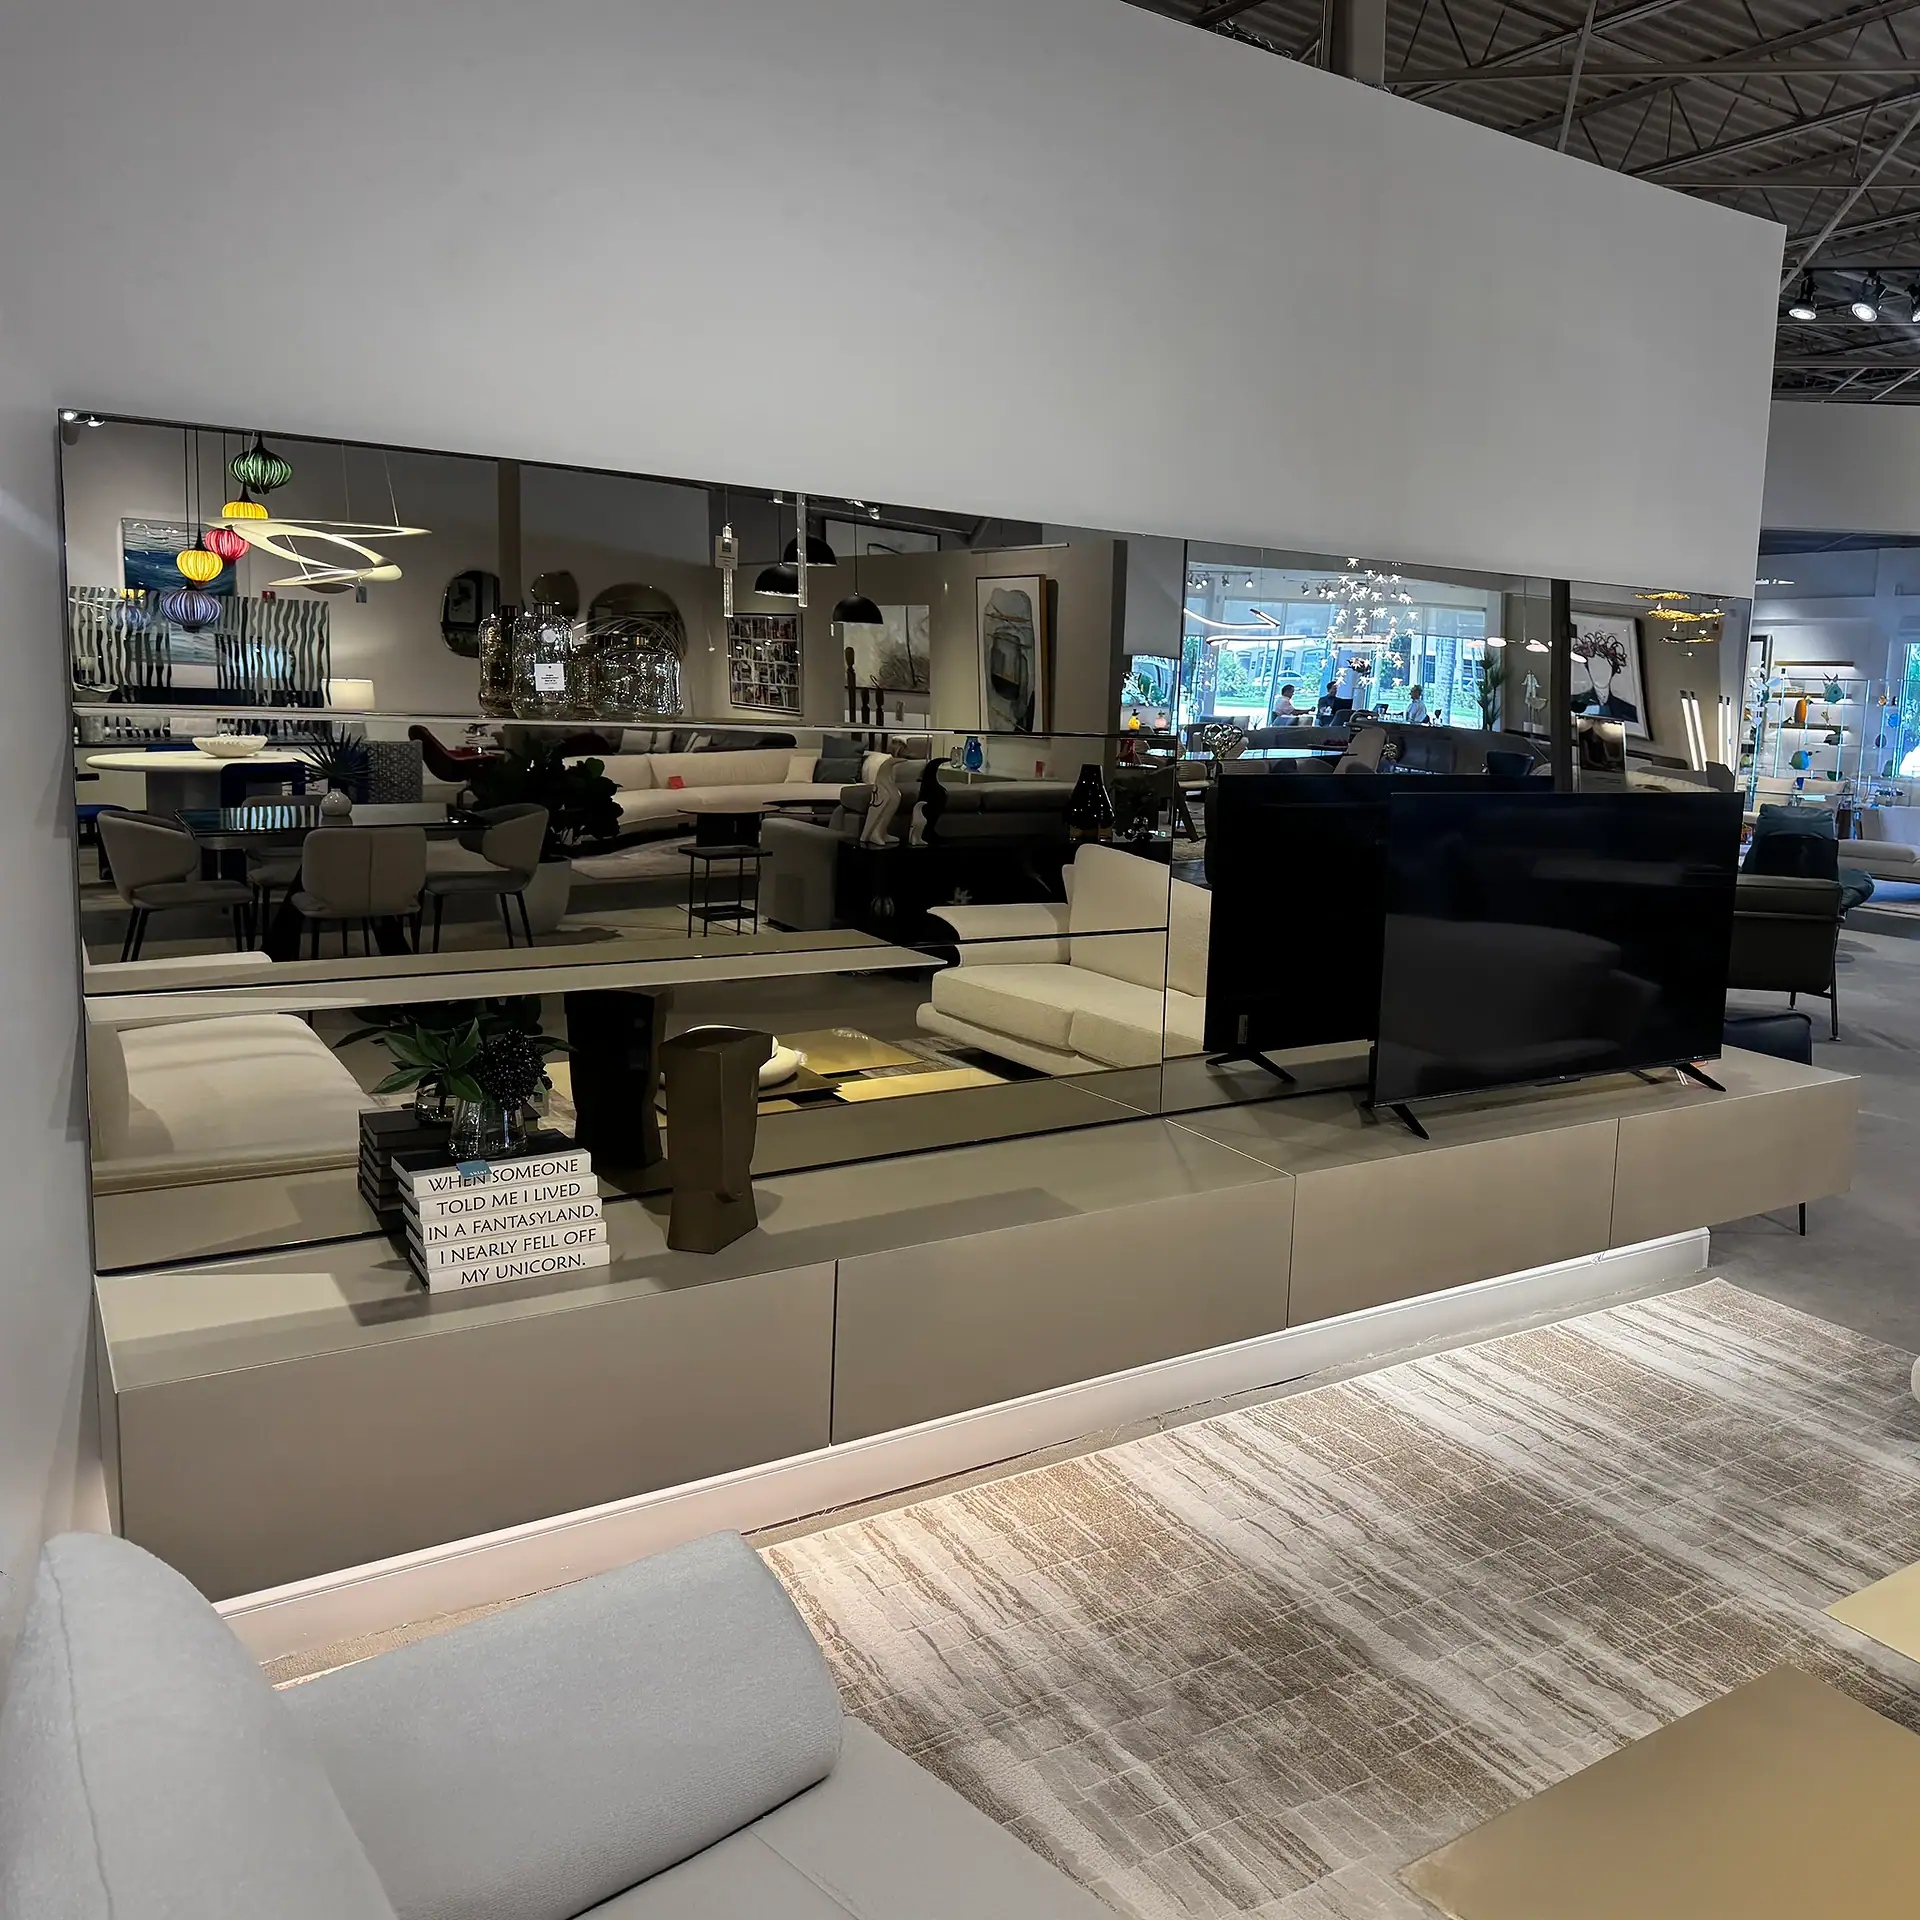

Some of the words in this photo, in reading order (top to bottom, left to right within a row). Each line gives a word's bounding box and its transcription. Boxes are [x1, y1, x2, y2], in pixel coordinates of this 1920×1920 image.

[492, 1159, 578, 1183] SOMEONE
[437, 1197, 486, 1215] TOLD
[492, 1191, 517, 1208] ME
[524, 1190, 528, 1203] I
[534, 1183, 581, 1201] LIVED
[428, 1225, 448, 1241] IN
[454, 1223, 467, 1237] A
[440, 1251, 444, 1265] I
[451, 1239, 518, 1263] NEARLY
[523, 1234, 558, 1251] FELL
[564, 1228, 597, 1245] OFF
[461, 1267, 490, 1285] MY
[496, 1253, 586, 1279] UNICORN.
